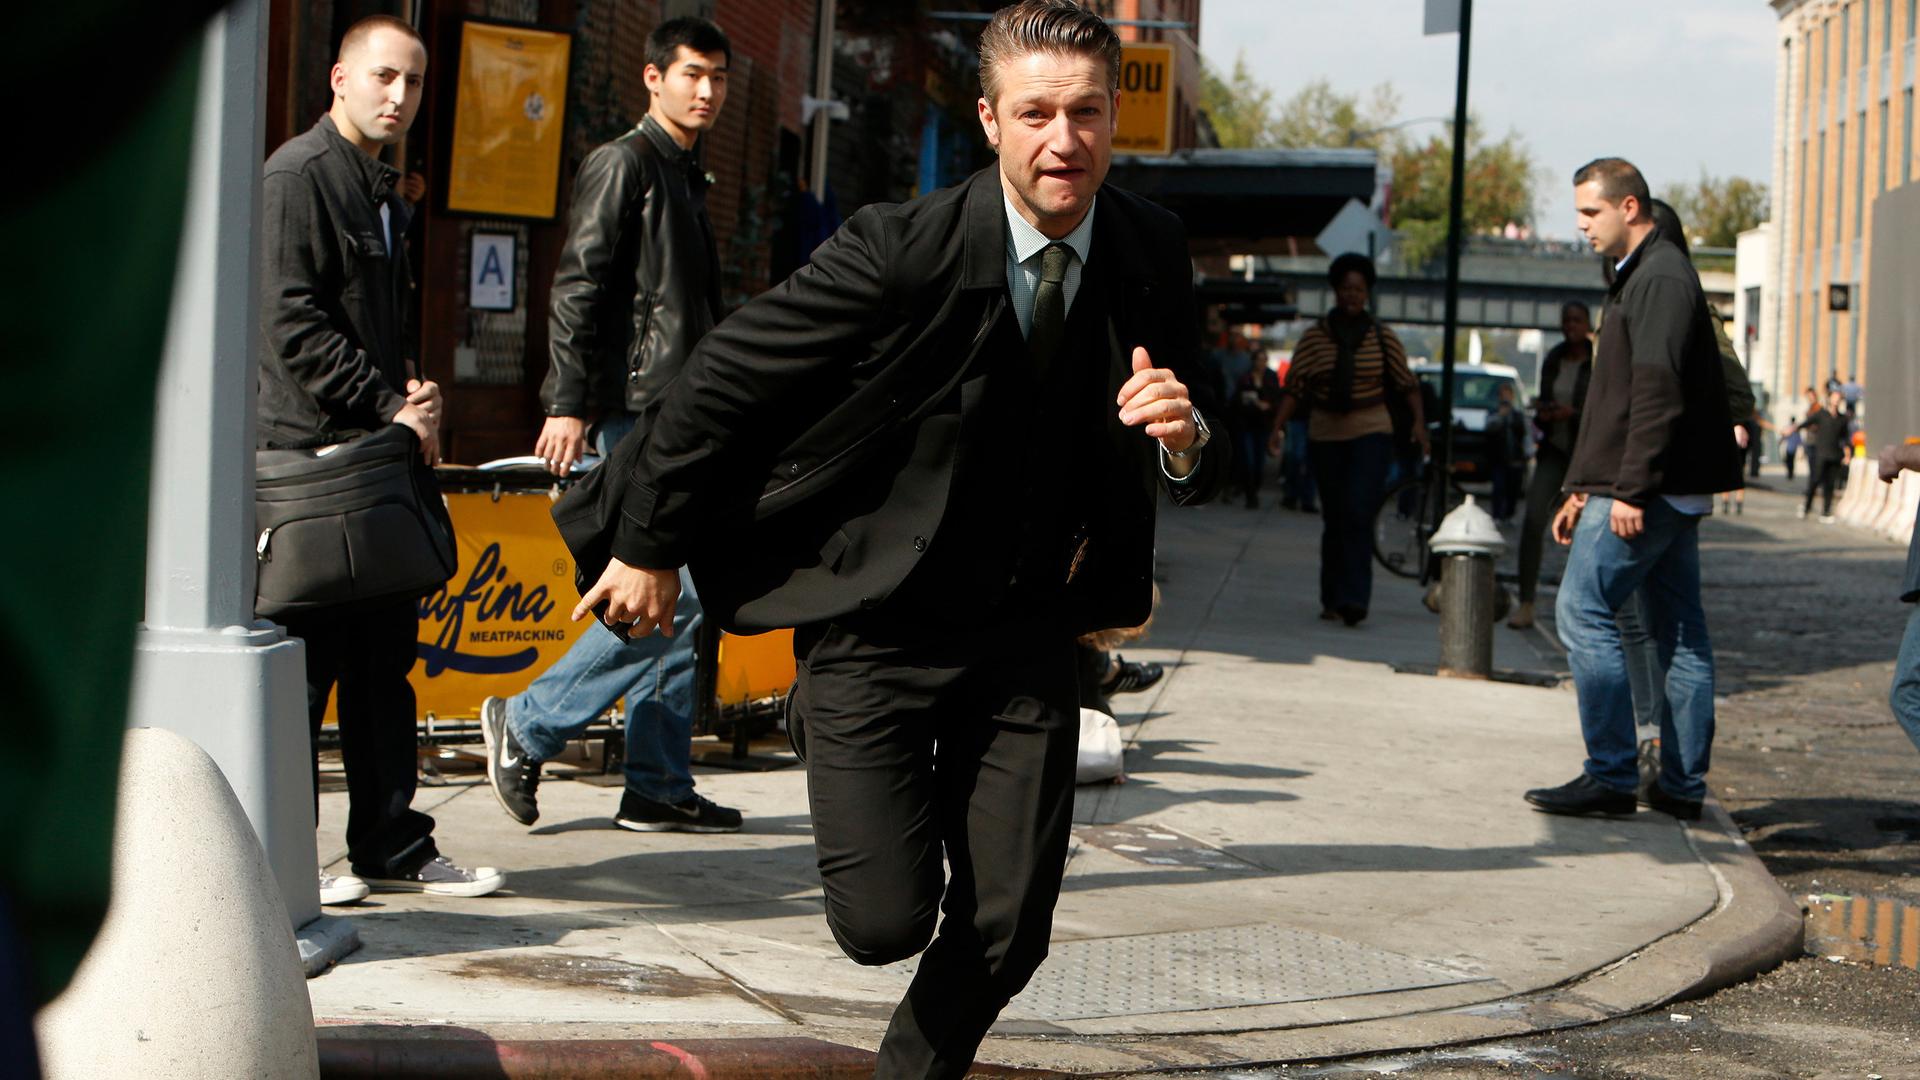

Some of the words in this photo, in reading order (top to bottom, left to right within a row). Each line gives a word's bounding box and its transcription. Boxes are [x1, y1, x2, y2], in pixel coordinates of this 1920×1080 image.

[1124, 61, 1163, 93] OU
[478, 244, 505, 286] A
[417, 542, 556, 678] afina
[469, 629, 565, 643] MEATPACKING
